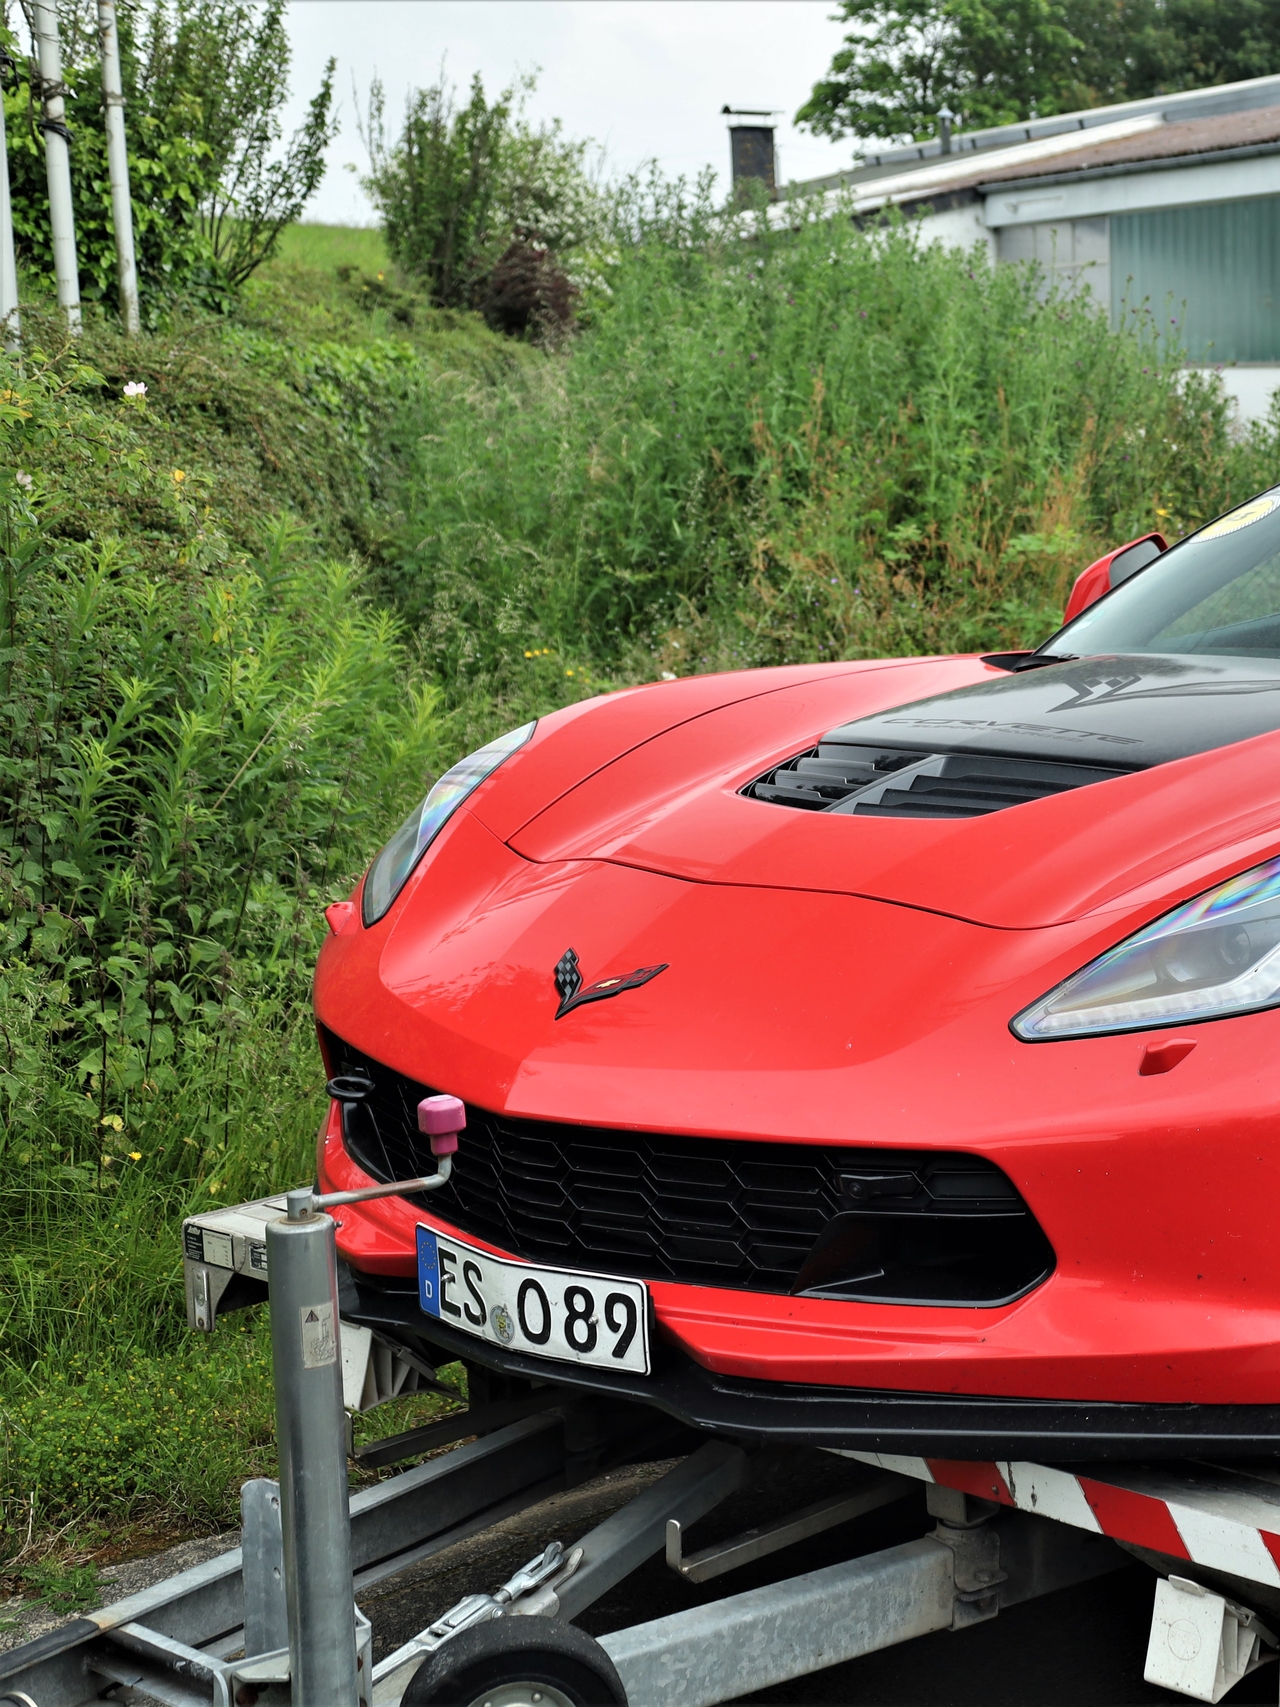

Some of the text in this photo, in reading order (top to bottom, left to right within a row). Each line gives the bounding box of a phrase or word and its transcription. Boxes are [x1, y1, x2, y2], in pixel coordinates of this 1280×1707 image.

[881, 718, 1144, 745] CORVETTE
[425, 1279, 433, 1299] D
[437, 1246, 488, 1327] ES
